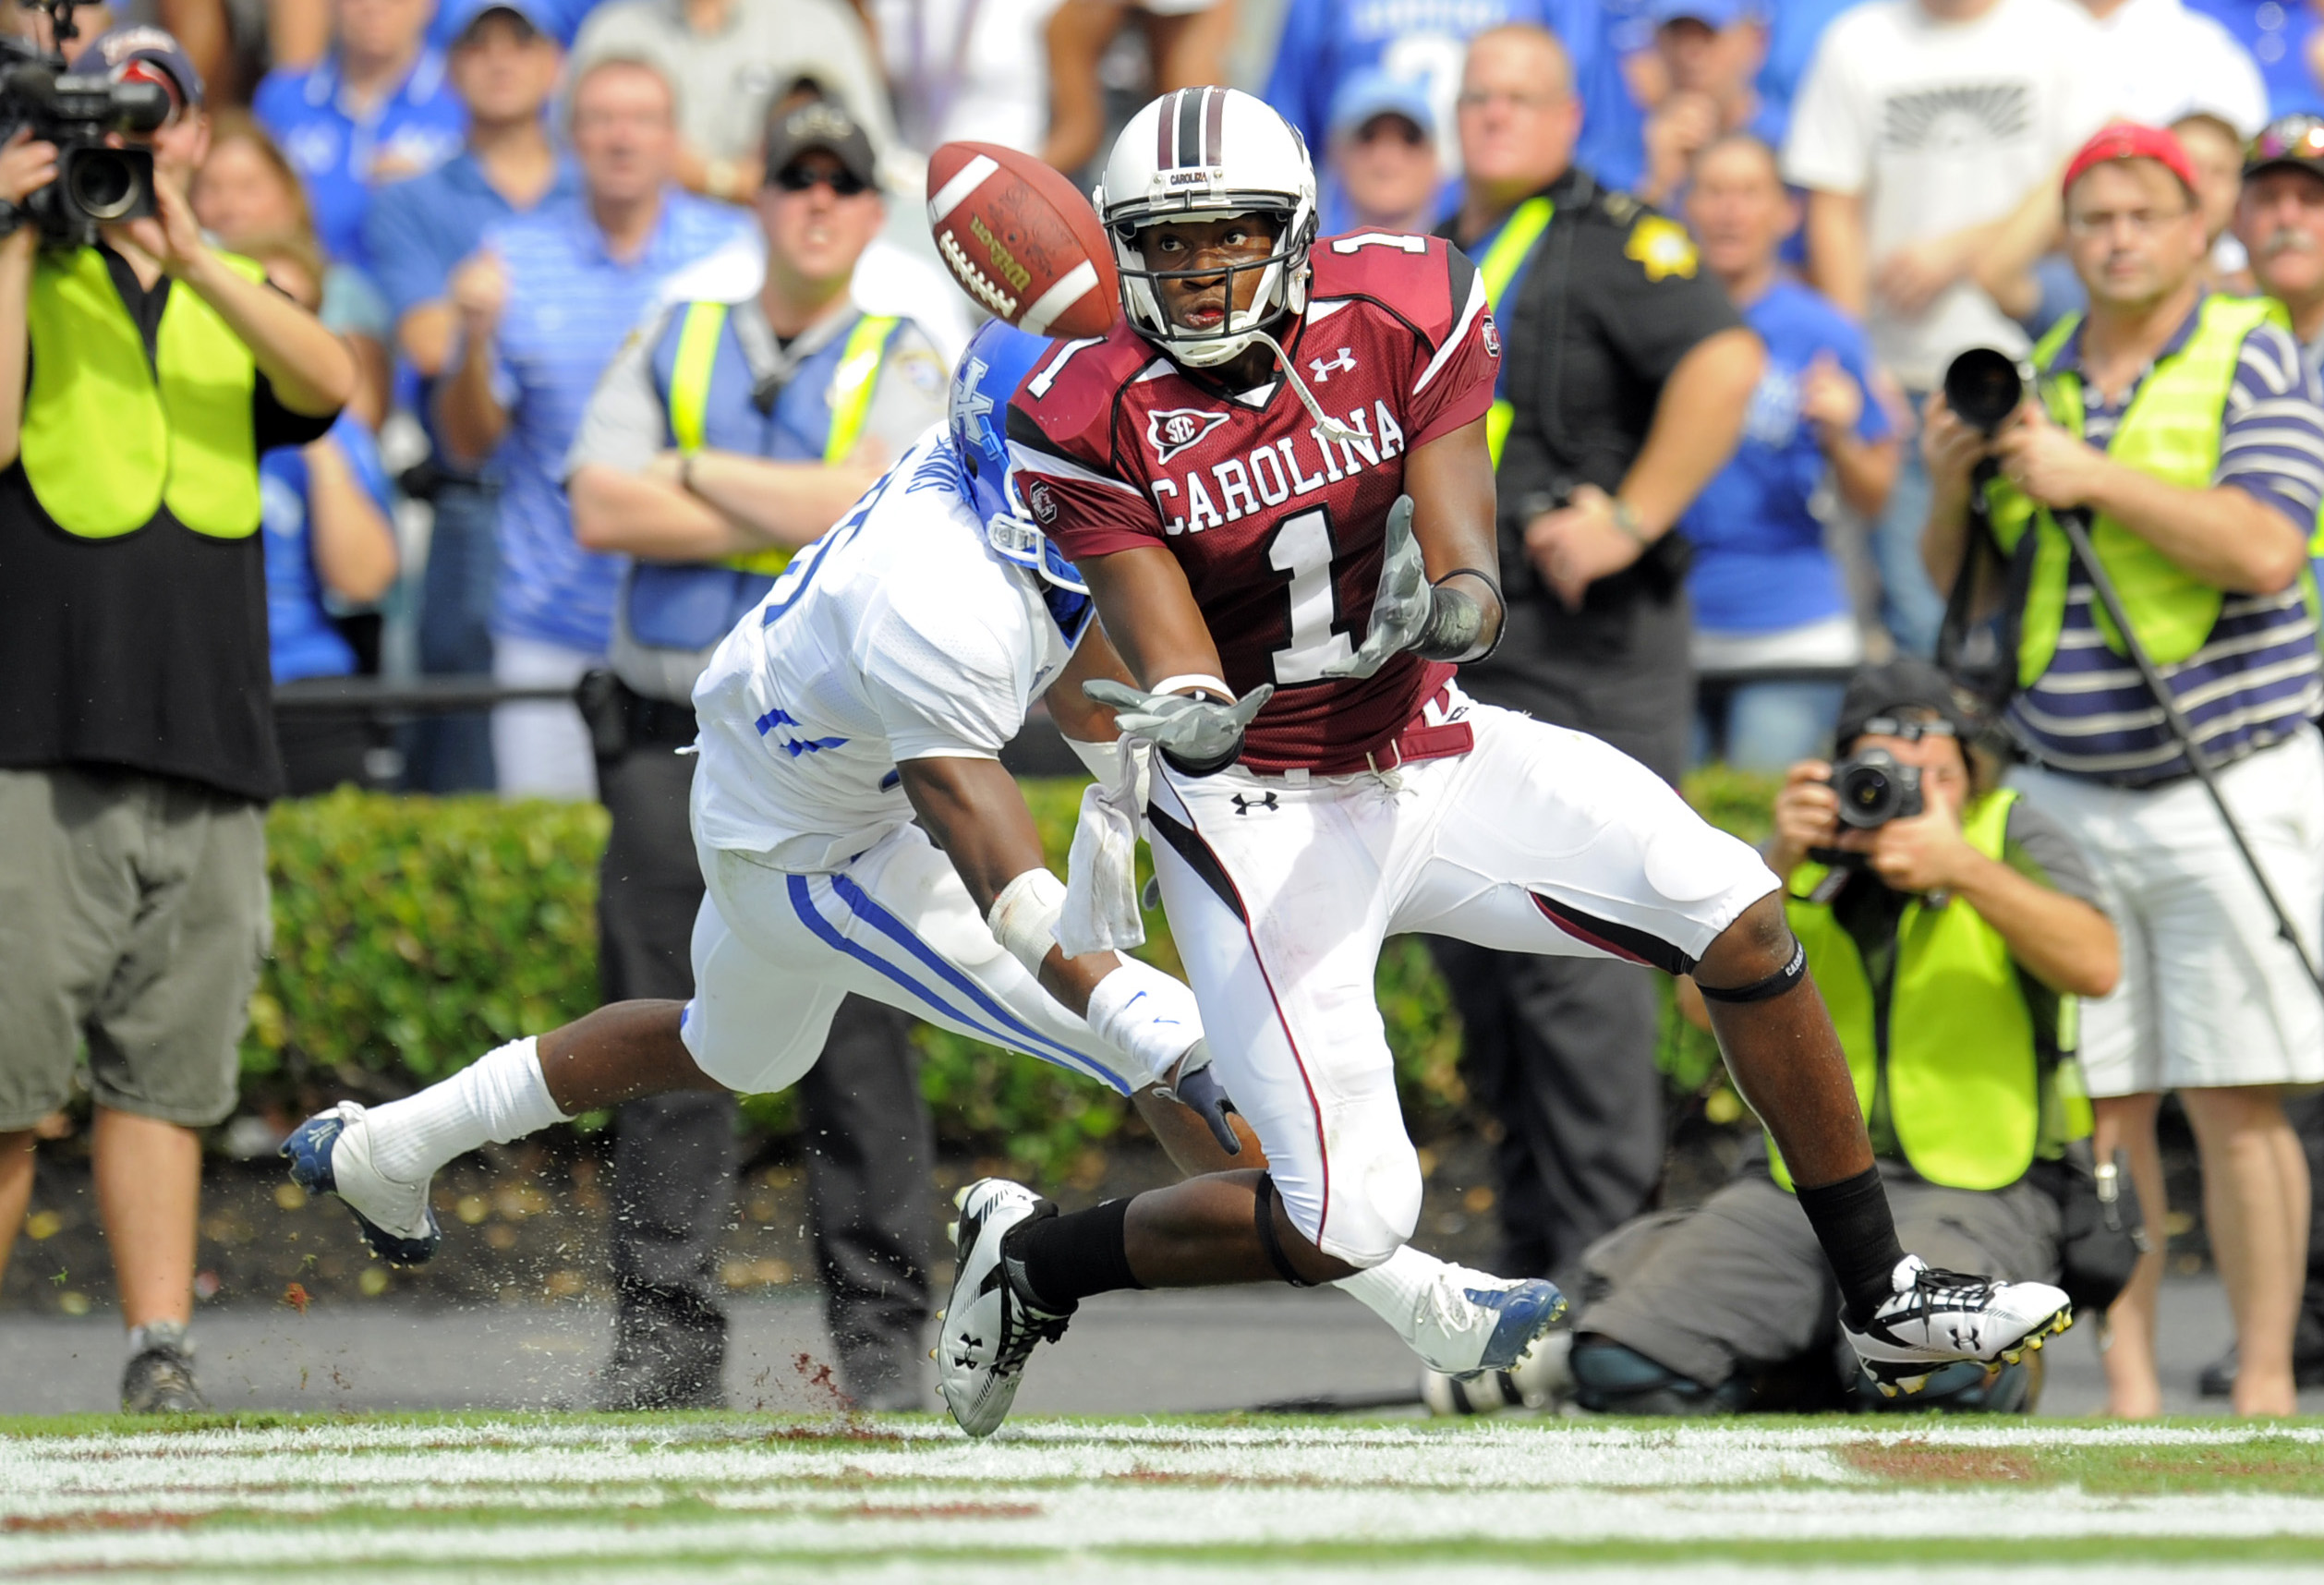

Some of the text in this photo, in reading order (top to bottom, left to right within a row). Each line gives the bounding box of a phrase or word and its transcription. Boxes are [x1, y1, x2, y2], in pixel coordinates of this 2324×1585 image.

[971, 214, 1031, 293] Wilson
[1151, 399, 1404, 536] CAROLINA
[1165, 416, 1196, 443] SEC
[1265, 504, 1356, 687] 1
